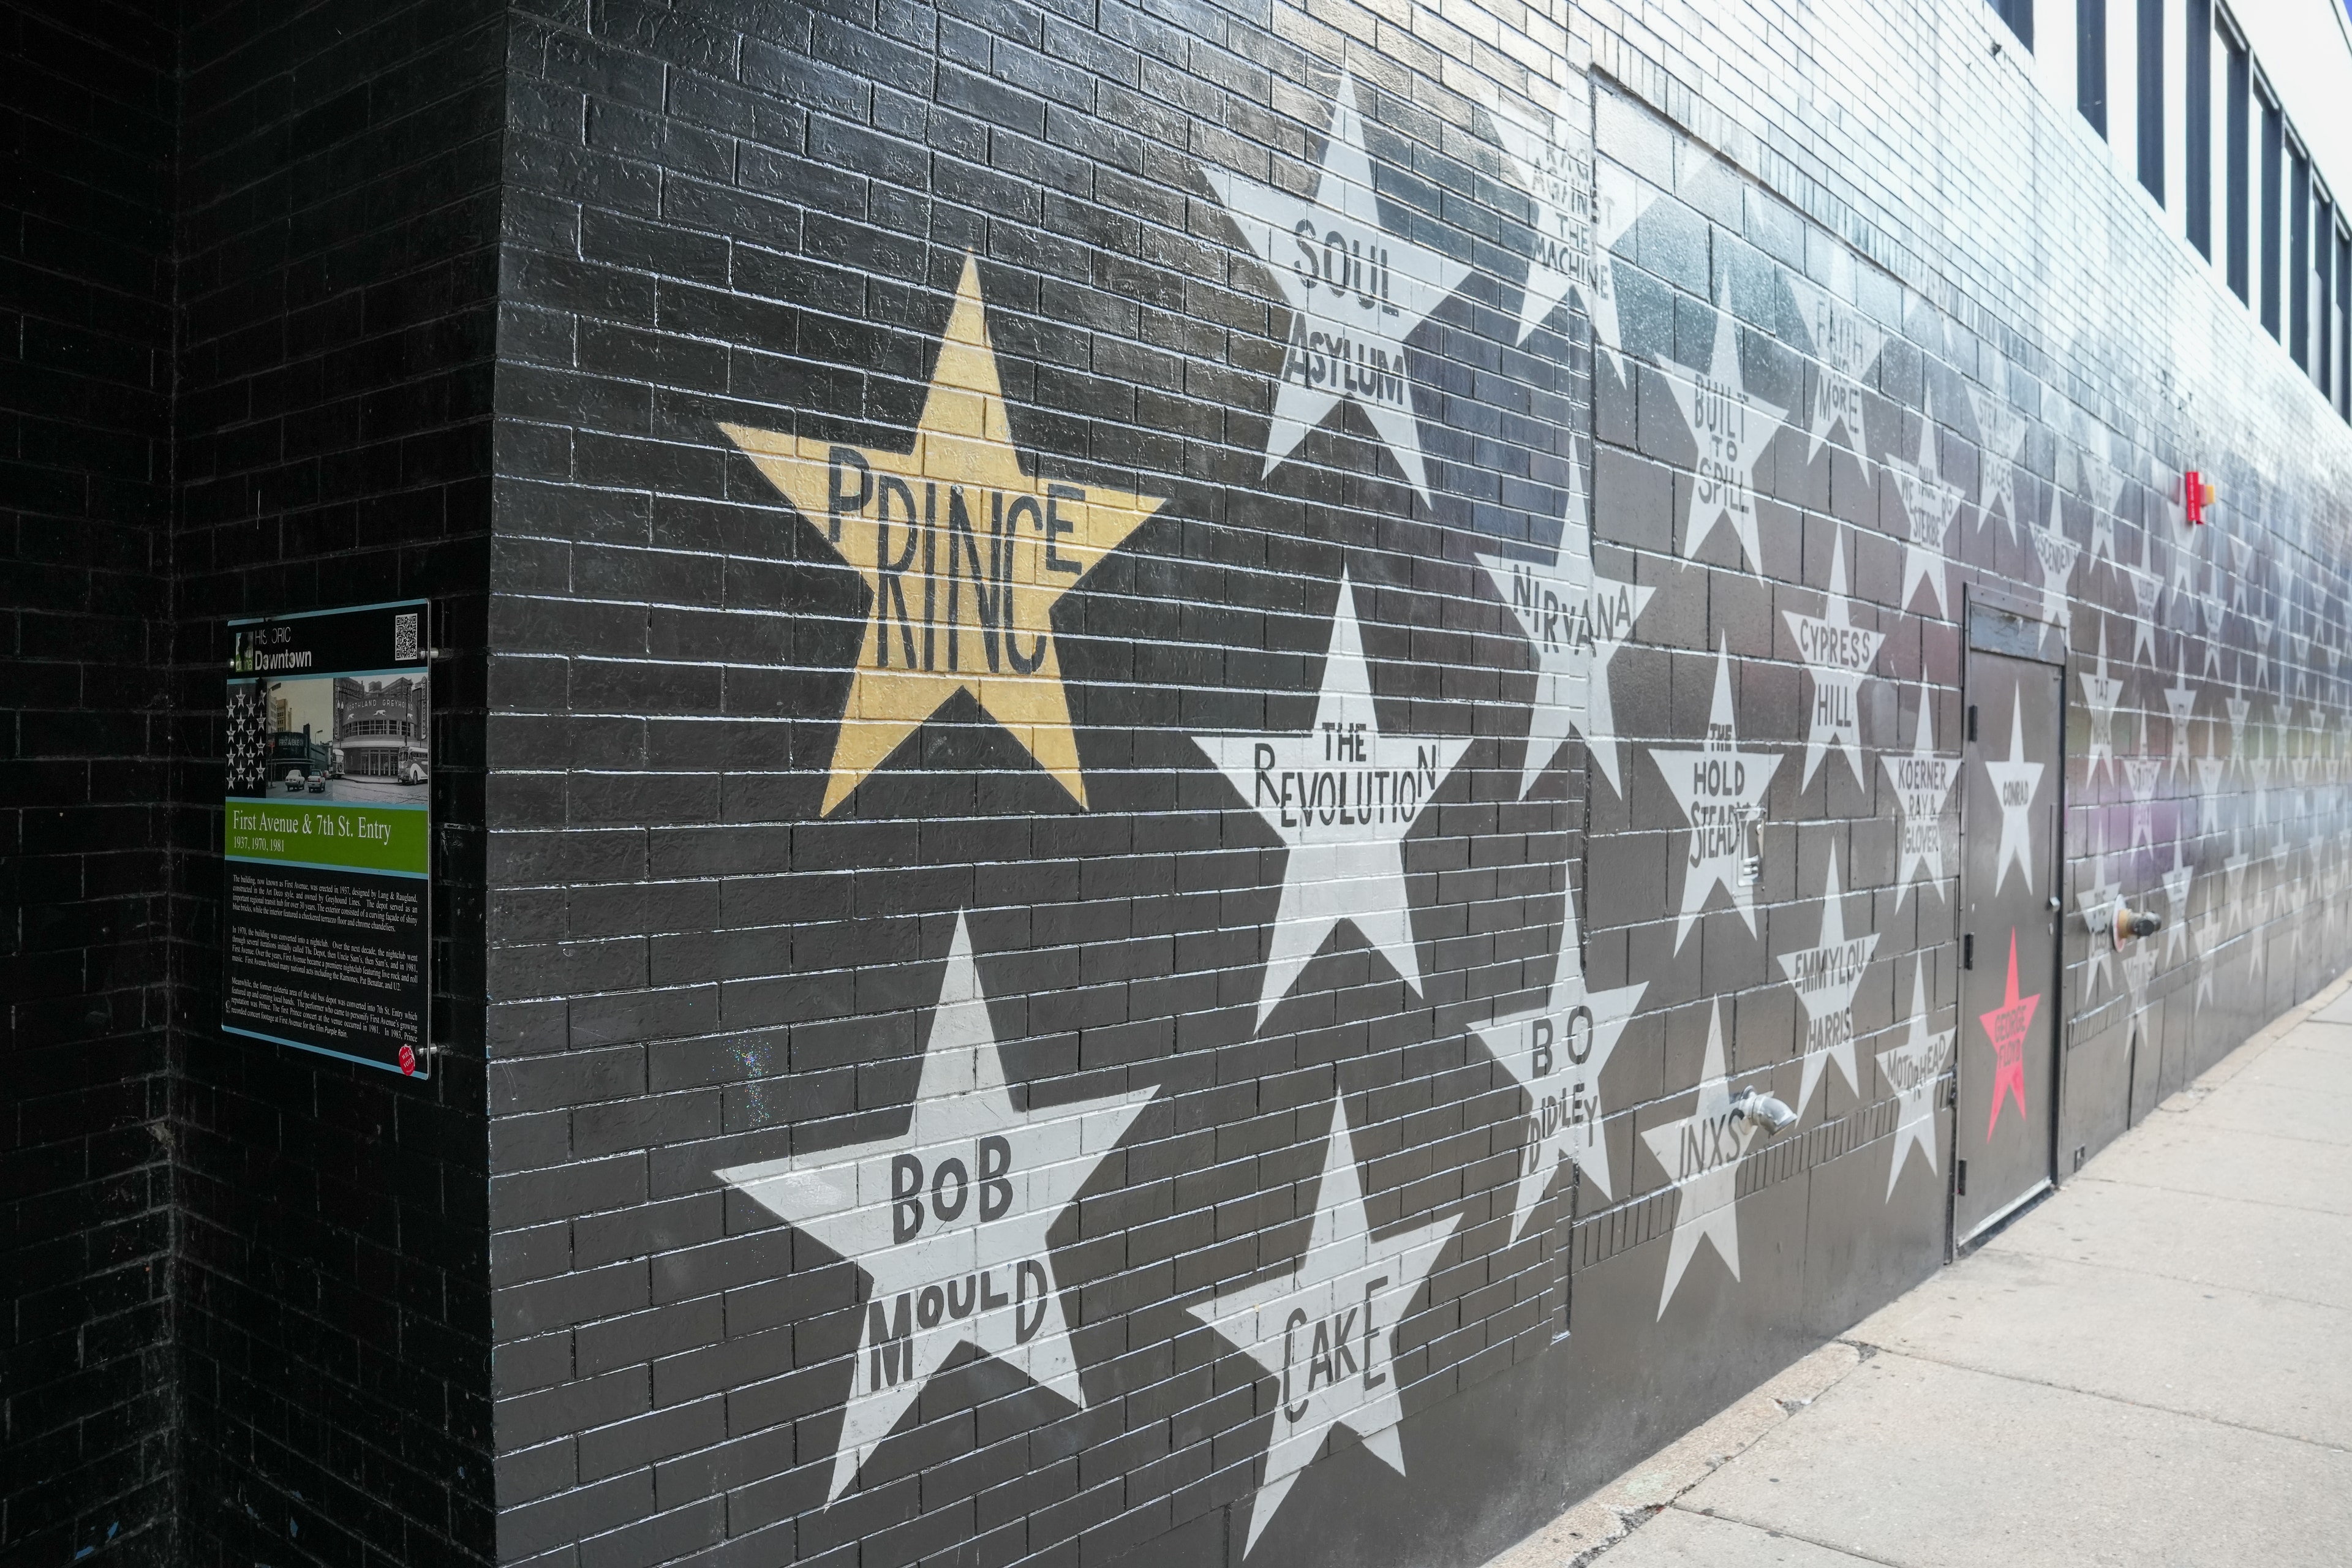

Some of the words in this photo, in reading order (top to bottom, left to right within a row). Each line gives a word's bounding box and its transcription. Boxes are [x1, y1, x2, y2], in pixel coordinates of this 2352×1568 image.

[1556, 212, 1591, 255] THE
[1294, 219, 1399, 318] SOUL
[1532, 237, 1610, 301] MACHINE
[1817, 301, 1863, 369] FAITH
[1286, 312, 1404, 406] ASYLUM
[1694, 372, 1750, 445] BUILT
[1819, 374, 1860, 435] MORE
[1710, 435, 1738, 463] TO
[1697, 456, 1750, 514] SPILL
[1985, 459, 2012, 503] FACES
[829, 445, 1086, 674] PRINCE
[1513, 564, 1632, 658] NIRVANA
[255, 627, 291, 646] HISORIC
[1800, 618, 1872, 668] CYPRESS
[254, 649, 312, 671] Downtown
[1817, 684, 1853, 728] HILL
[1322, 722, 1367, 763] THE
[1709, 723, 1732, 753] THE
[1254, 742, 1437, 829] REVOLUTION
[1693, 760, 1745, 796] HOLD
[2002, 780, 2029, 807] CONRAD
[233, 810, 256, 830] First
[259, 812, 298, 834] Avenue
[302, 813, 312, 834] &
[316, 814, 334, 836] 7th
[338, 815, 353, 837] St.
[358, 817, 391, 846] Entry
[1908, 793, 1928, 821] RAY
[1930, 793, 1938, 822] &
[233, 836, 251, 851] 1937,
[251, 837, 268, 853] 1970,
[270, 839, 284, 852] 1981
[1689, 801, 1751, 869] STEADY
[1904, 825, 1939, 854] GLOVER
[233, 883, 252, 893] constructed
[273, 888, 283, 897] Deco
[304, 892, 317, 900] owned
[318, 893, 323, 903] by
[325, 894, 347, 906] Greyhound
[376, 900, 387, 911] depot
[390, 901, 403, 911] served
[266, 878, 277, 886] known
[319, 883, 333, 892] erected
[352, 887, 369, 899] designed
[371, 889, 376, 899] by
[378, 889, 388, 900] Lang
[390, 891, 394, 899] &
[255, 929, 269, 940] building
[279, 932, 296, 943] converted
[333, 940, 342, 949] Over
[351, 943, 360, 952] next
[386, 948, 405, 962] nightclub
[407, 952, 418, 962] went
[1794, 938, 1867, 995] EMMYLOU
[231, 995, 249, 1007] reputation
[290, 1007, 301, 1017] Prince
[303, 1009, 317, 1020] concert
[331, 1017, 342, 1026] venue
[344, 1018, 361, 1030] occurred
[363, 1022, 367, 1031] in
[385, 1027, 388, 1036] In
[404, 1031, 417, 1042] Prince
[231, 1005, 246, 1015] recorded
[247, 1008, 260, 1018] concert
[261, 1011, 274, 1023] footage
[288, 1017, 301, 1028] Avenue
[325, 1025, 337, 1038] Purple
[260, 981, 271, 991] former
[273, 984, 288, 994] cafeteria
[298, 989, 301, 997] of
[325, 994, 336, 1006] depot
[346, 998, 366, 1010] converted
[392, 1007, 403, 1019] Entry
[405, 1009, 418, 1020] which
[1807, 1006, 1853, 1055] HARRIS
[403, 1057, 413, 1068] VOTE
[1679, 1107, 1744, 1180] INXS
[891, 1134, 1012, 1245] BOB
[865, 1258, 1049, 1393] MOULD
[1281, 1275, 1389, 1425] CAKE
